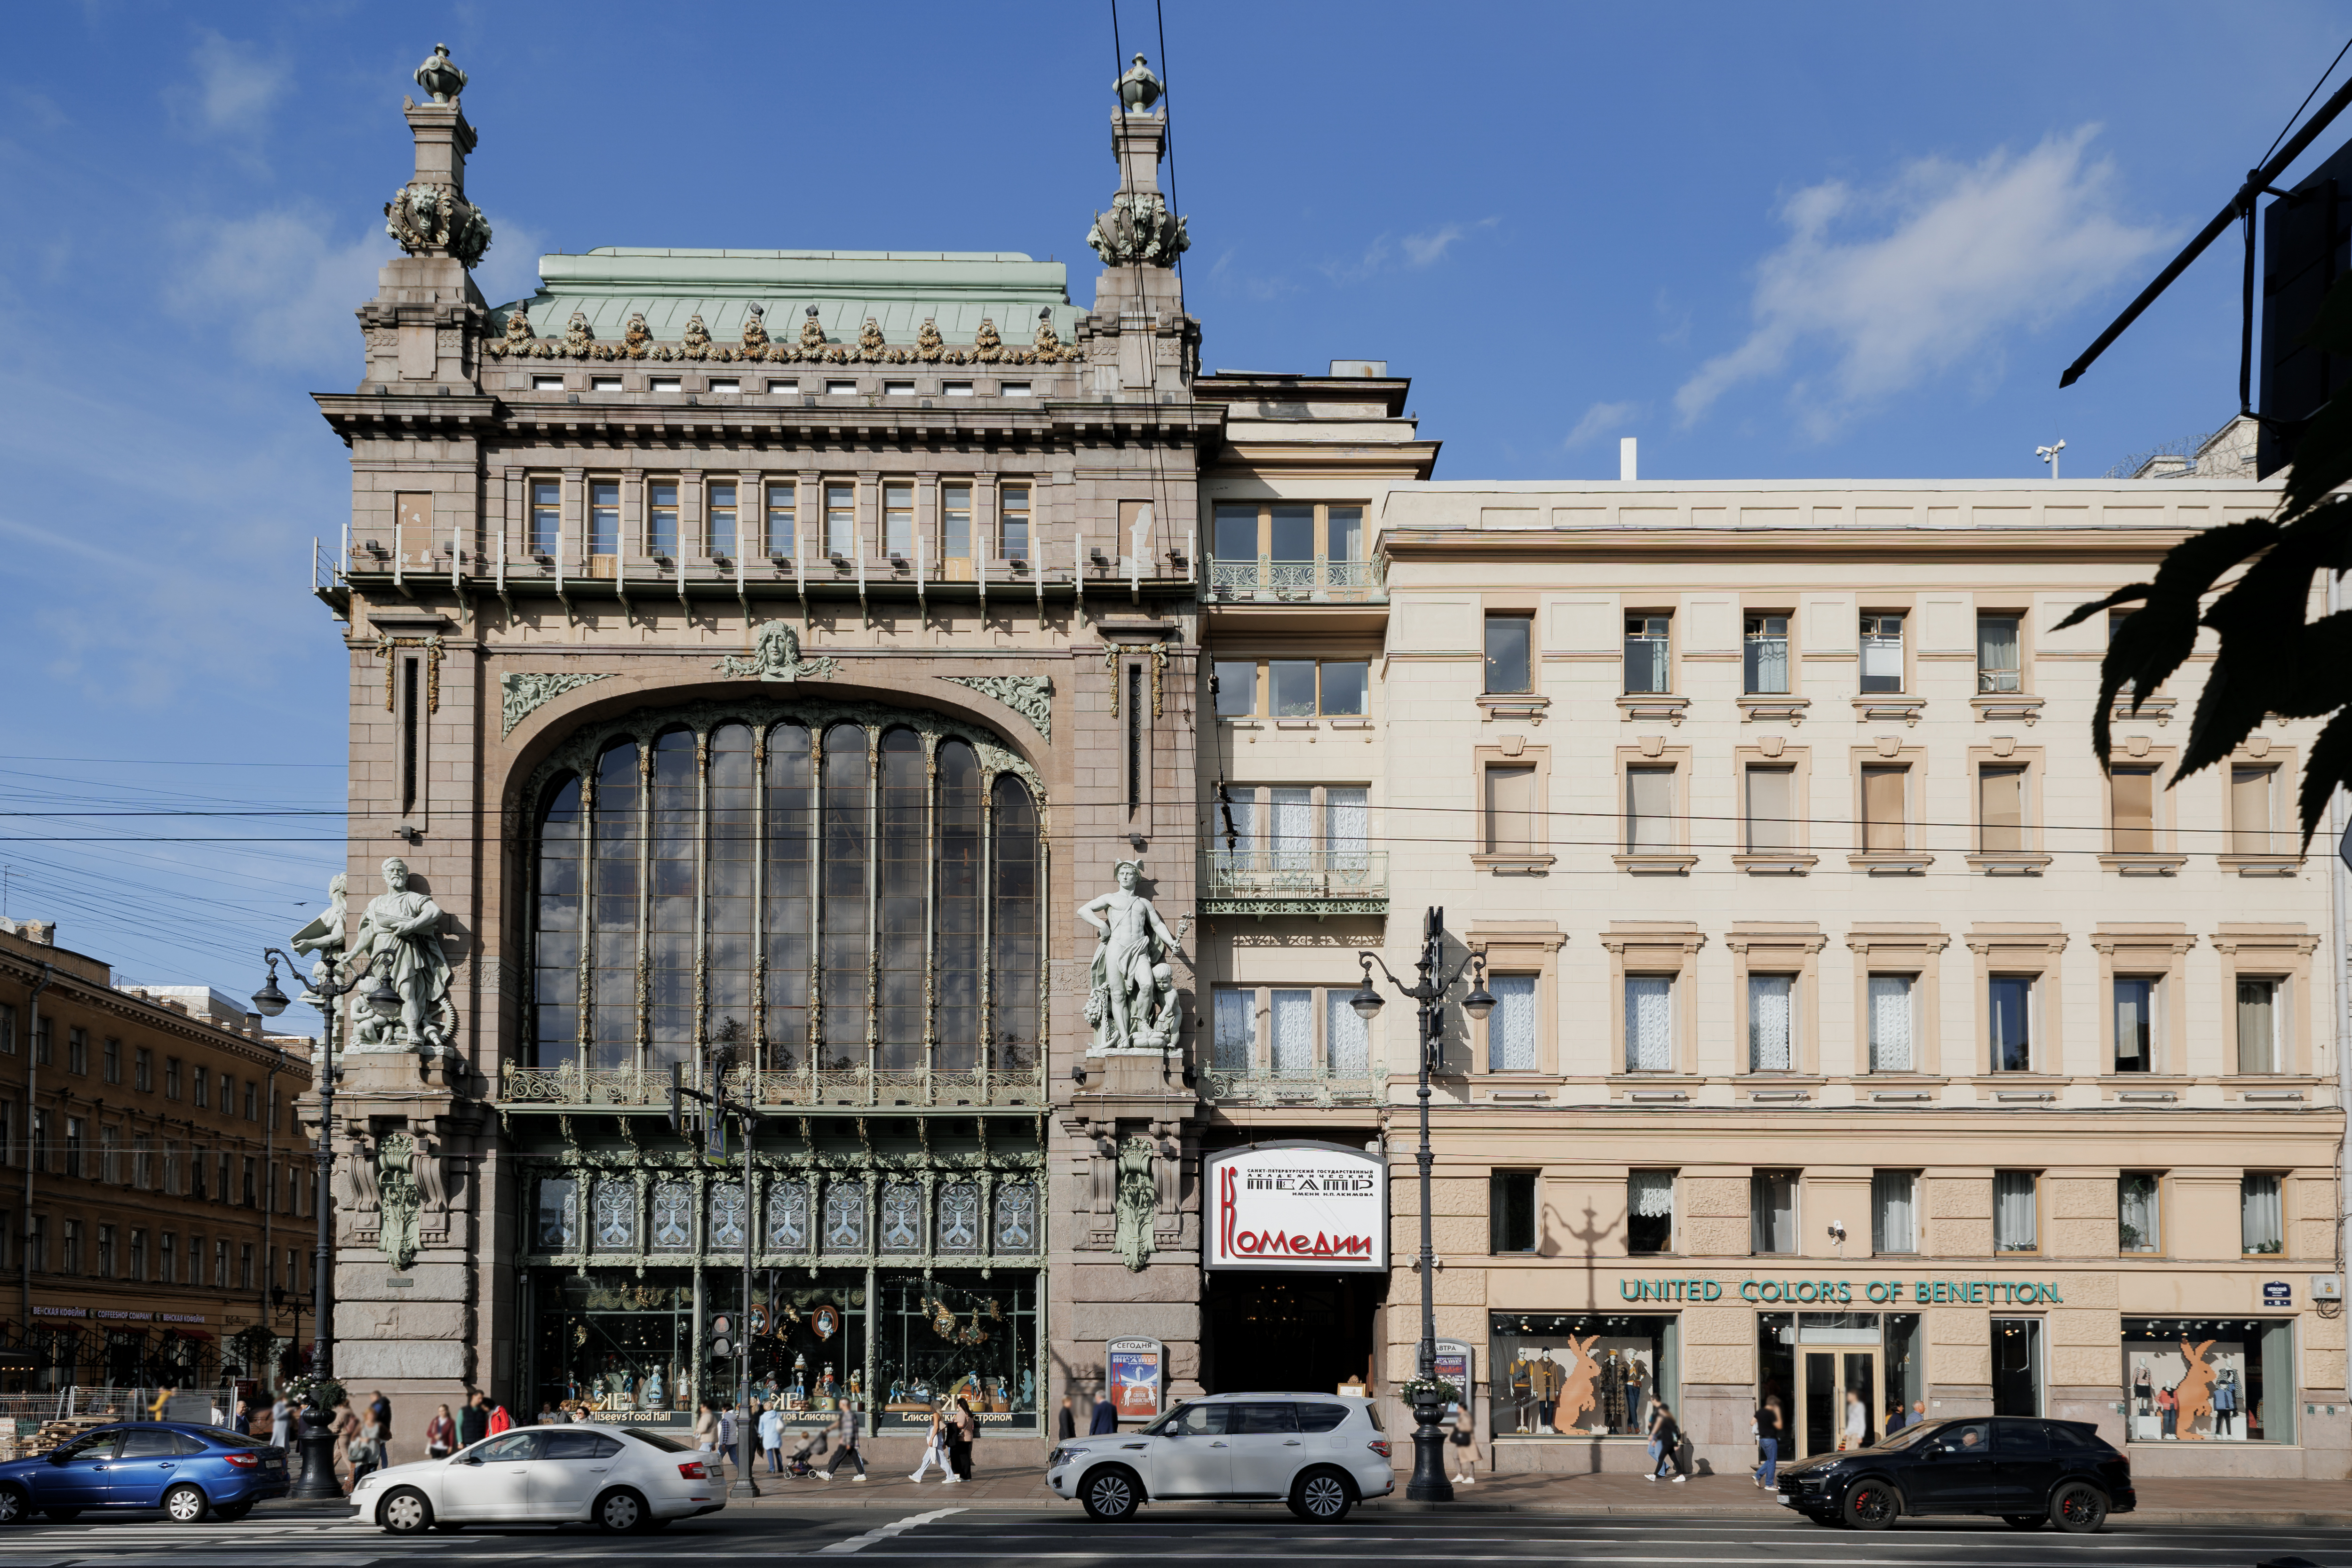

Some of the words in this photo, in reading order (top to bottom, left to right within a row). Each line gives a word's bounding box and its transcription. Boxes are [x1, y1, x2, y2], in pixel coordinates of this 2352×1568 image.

[1248, 1178, 1373, 1190] ТЕАТР
[1620, 1279, 1721, 1299] UNITED
[1740, 1280, 1851, 1301] COLORS
[1865, 1280, 1903, 1301] OF
[1915, 1281, 2064, 1302] BENETTON.
[33, 1306, 59, 1316] ВЕНСКАЯ
[59, 1307, 86, 1317] КОФЕЙНЯ
[98, 1310, 128, 1319] COFFEESHOP
[183, 1314, 205, 1323] КОФЕЙНЯ
[591, 1411, 628, 1421] liseevs
[628, 1411, 652, 1421] Food
[653, 1411, 671, 1421] Hall
[973, 1413, 1013, 1424] строном
